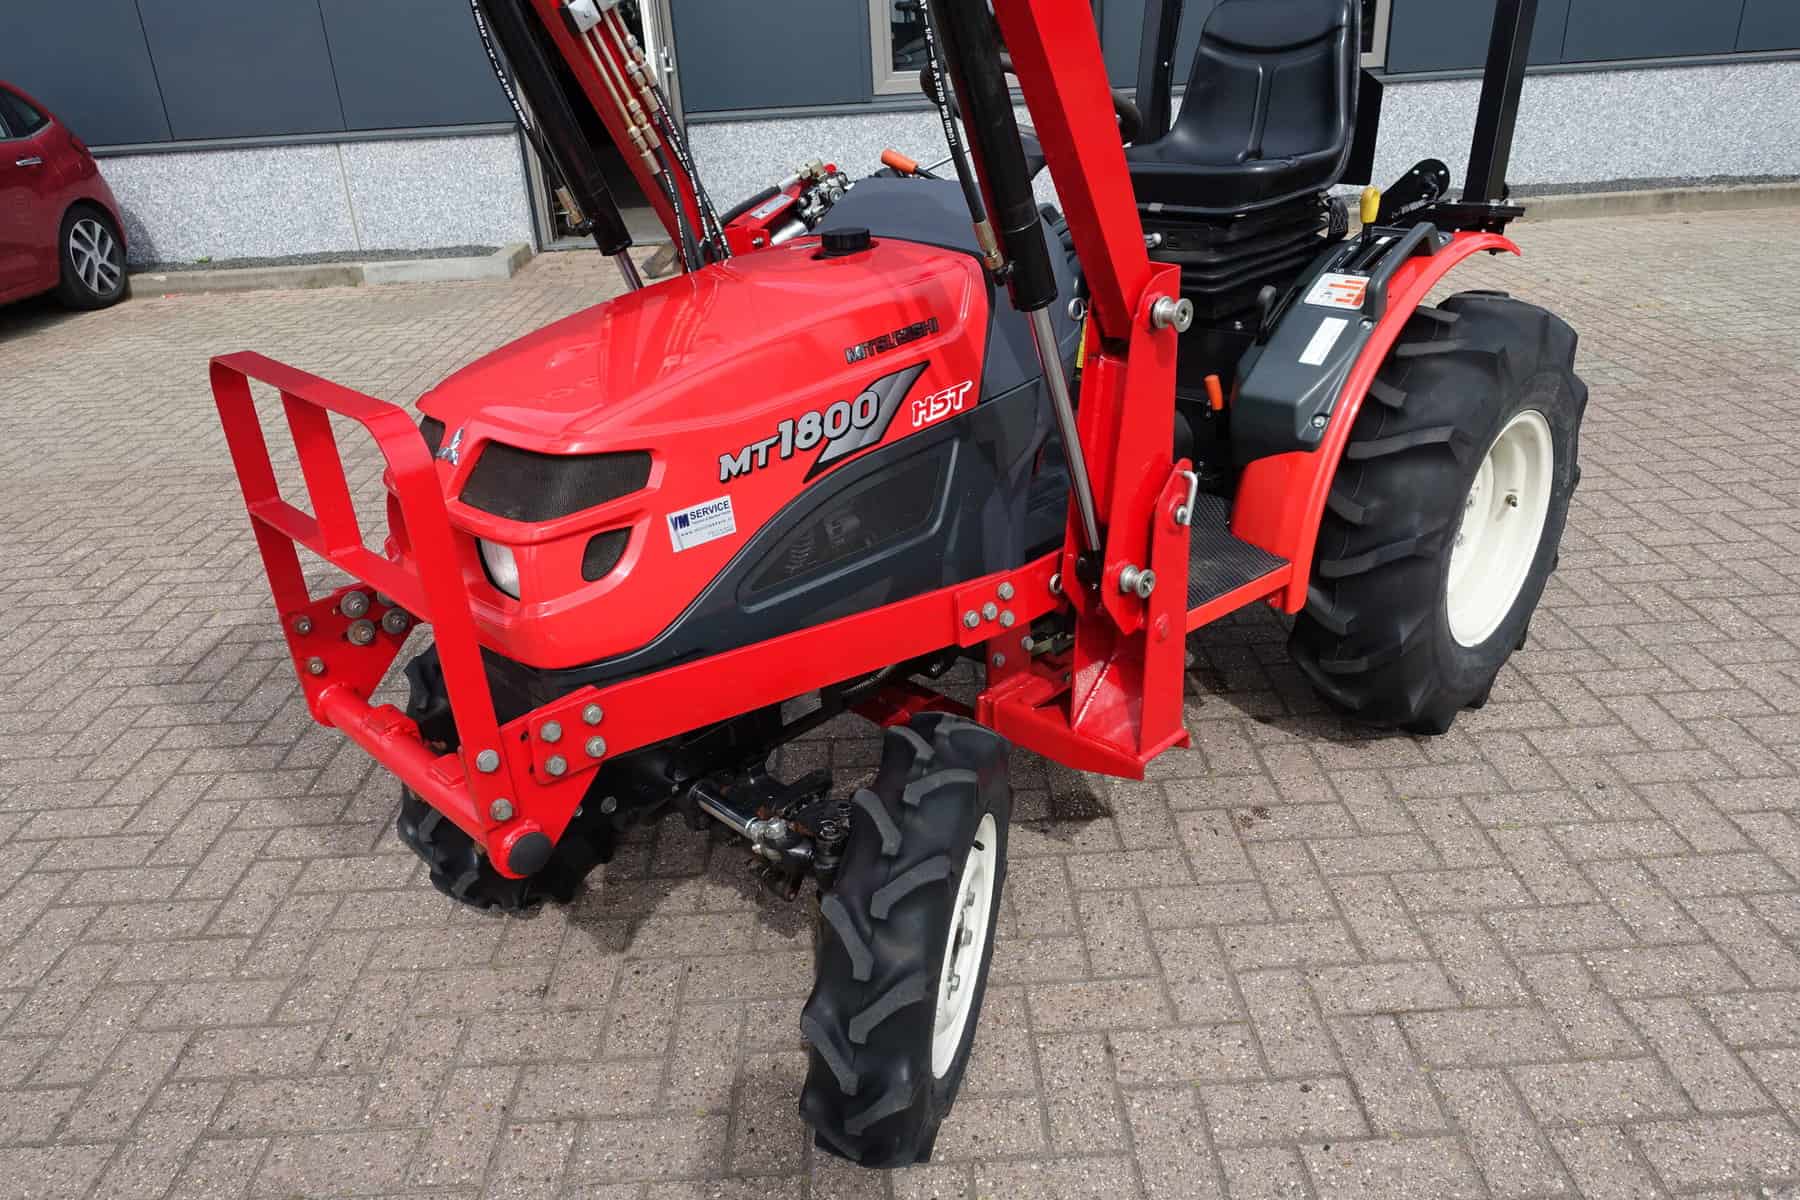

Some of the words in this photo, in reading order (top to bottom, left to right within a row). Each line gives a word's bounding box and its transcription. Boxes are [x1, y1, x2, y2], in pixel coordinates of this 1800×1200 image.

[844, 316, 939, 365] MITSUBISHI
[912, 380, 973, 427] HST
[718, 390, 880, 483] MT1800
[669, 513, 690, 531] VM
[689, 500, 730, 520] SERVICE
